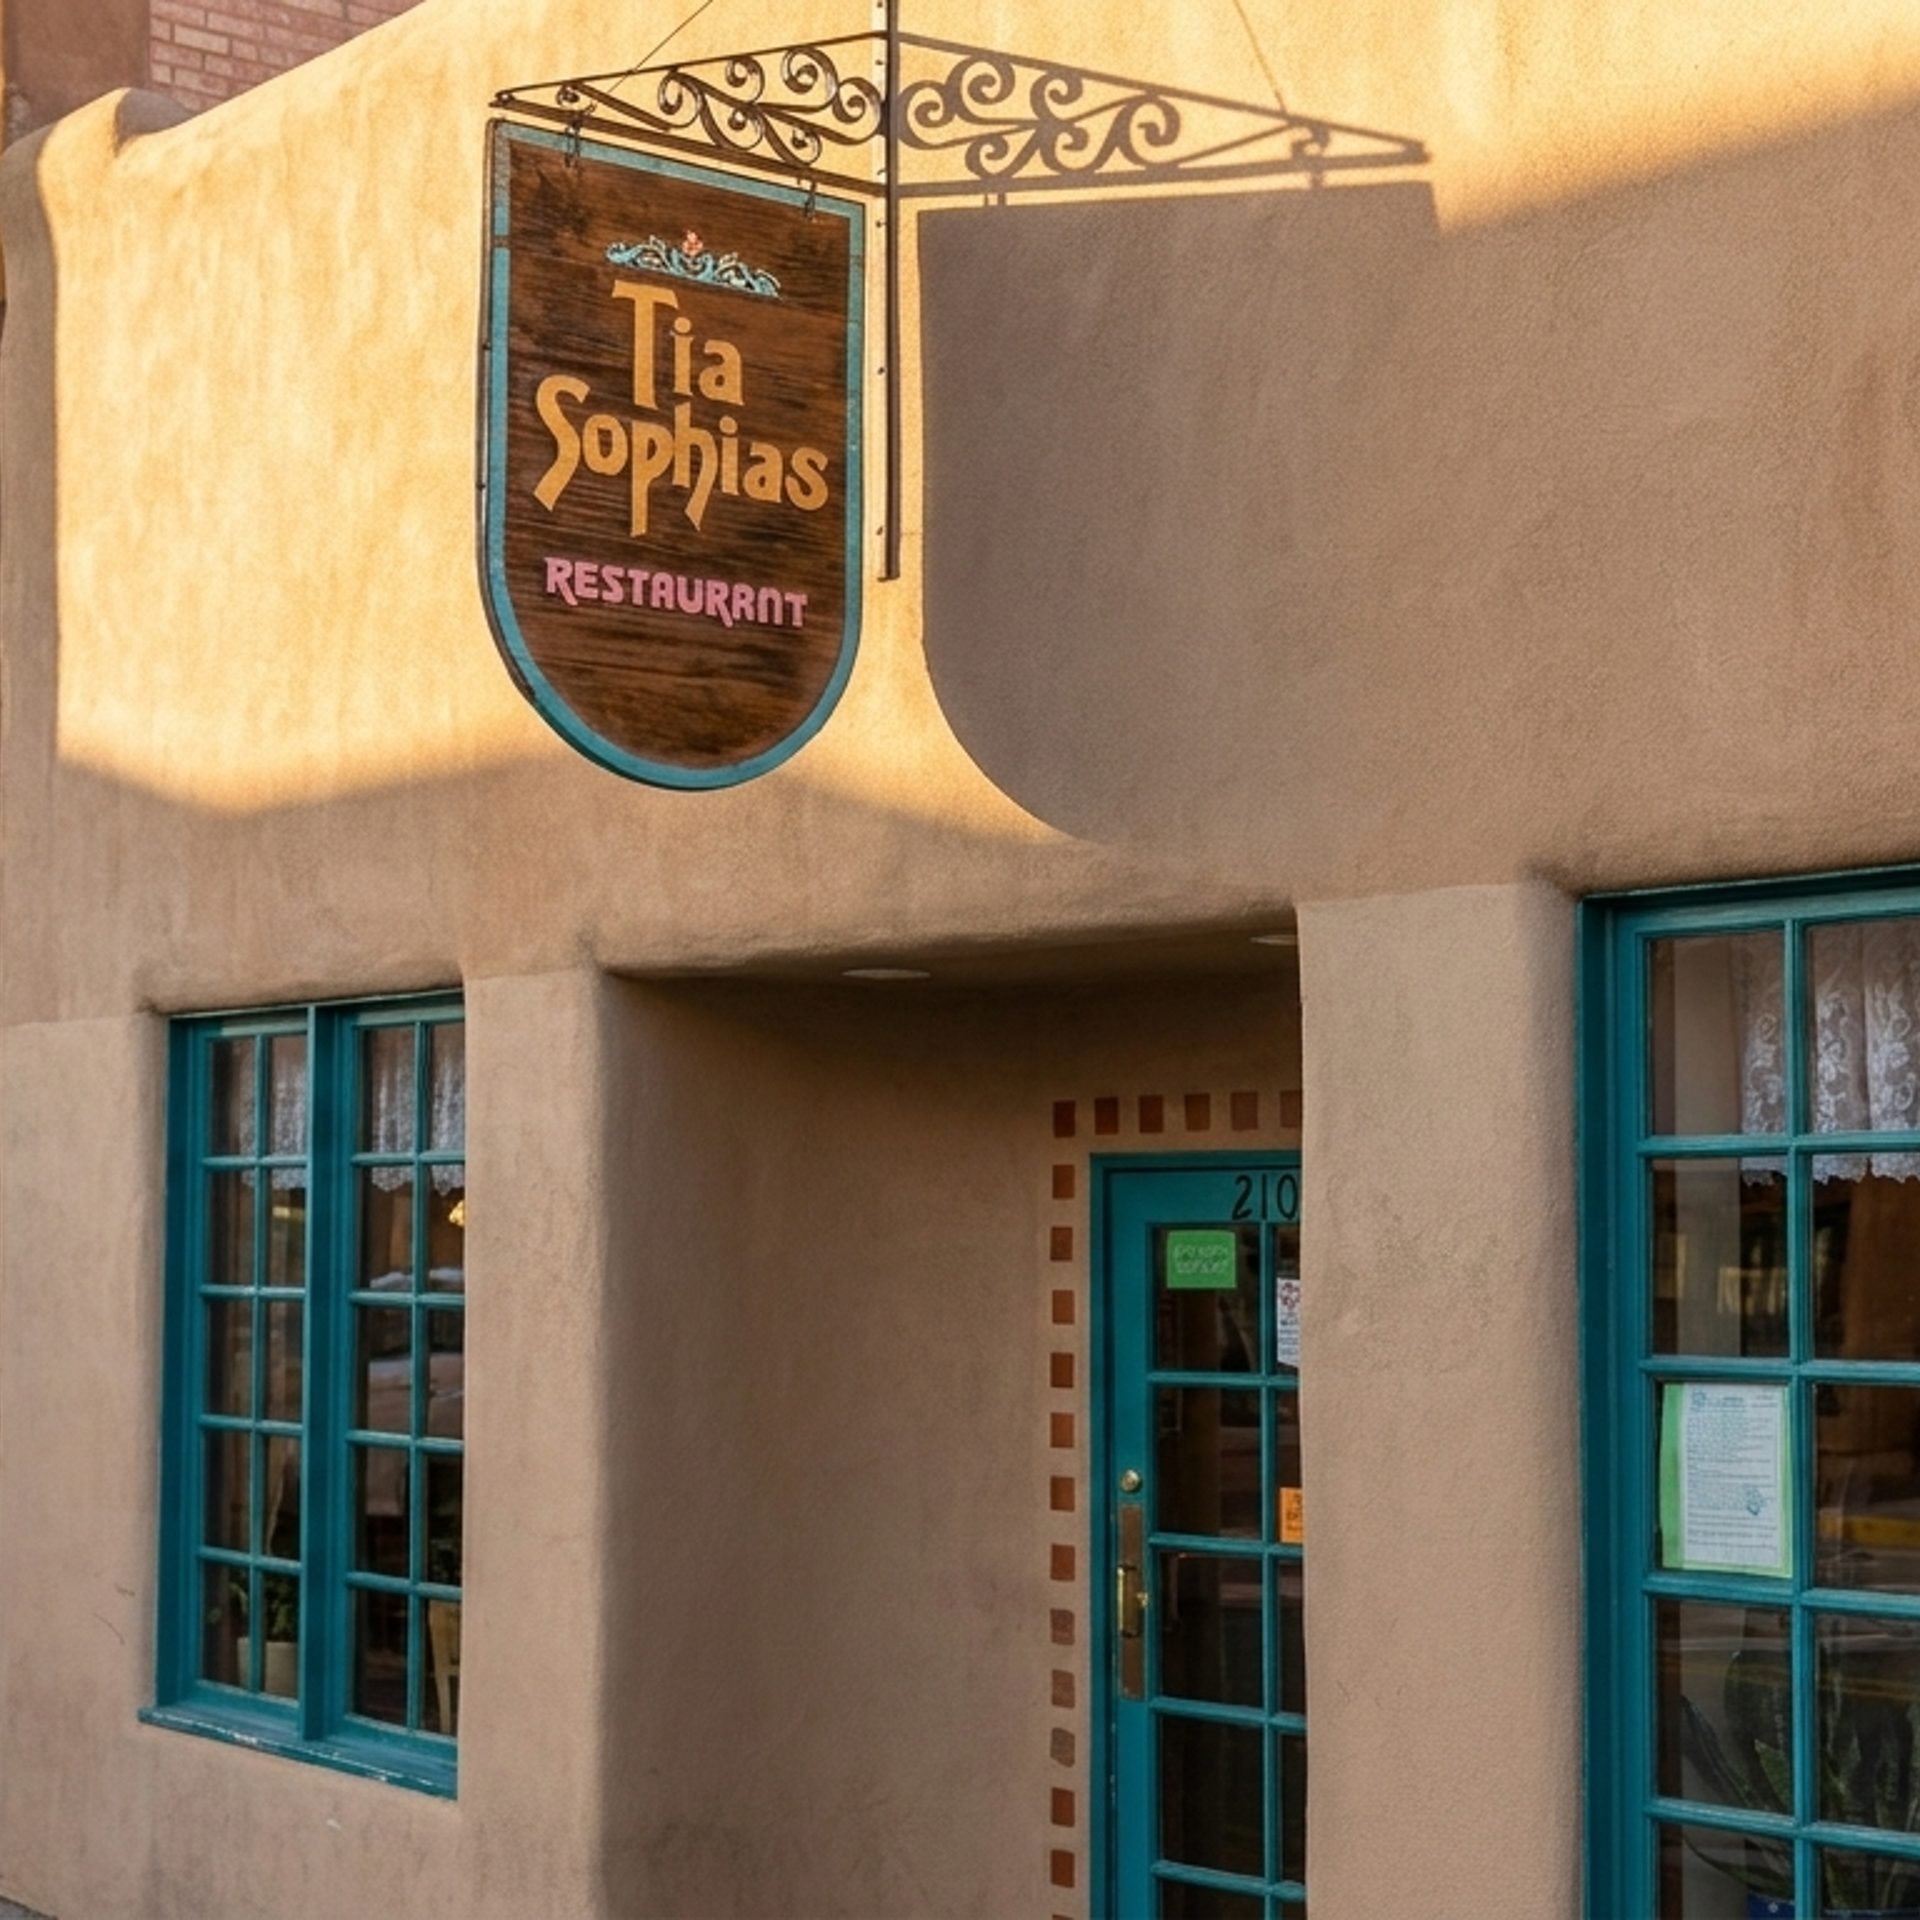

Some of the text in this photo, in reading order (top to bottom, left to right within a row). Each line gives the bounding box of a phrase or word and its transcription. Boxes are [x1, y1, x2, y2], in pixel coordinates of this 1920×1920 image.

[612, 279, 744, 410] Tia
[533, 374, 829, 538] Sophias
[544, 557, 809, 628] RESTAURANT
[1231, 1173, 1299, 1220] 210
